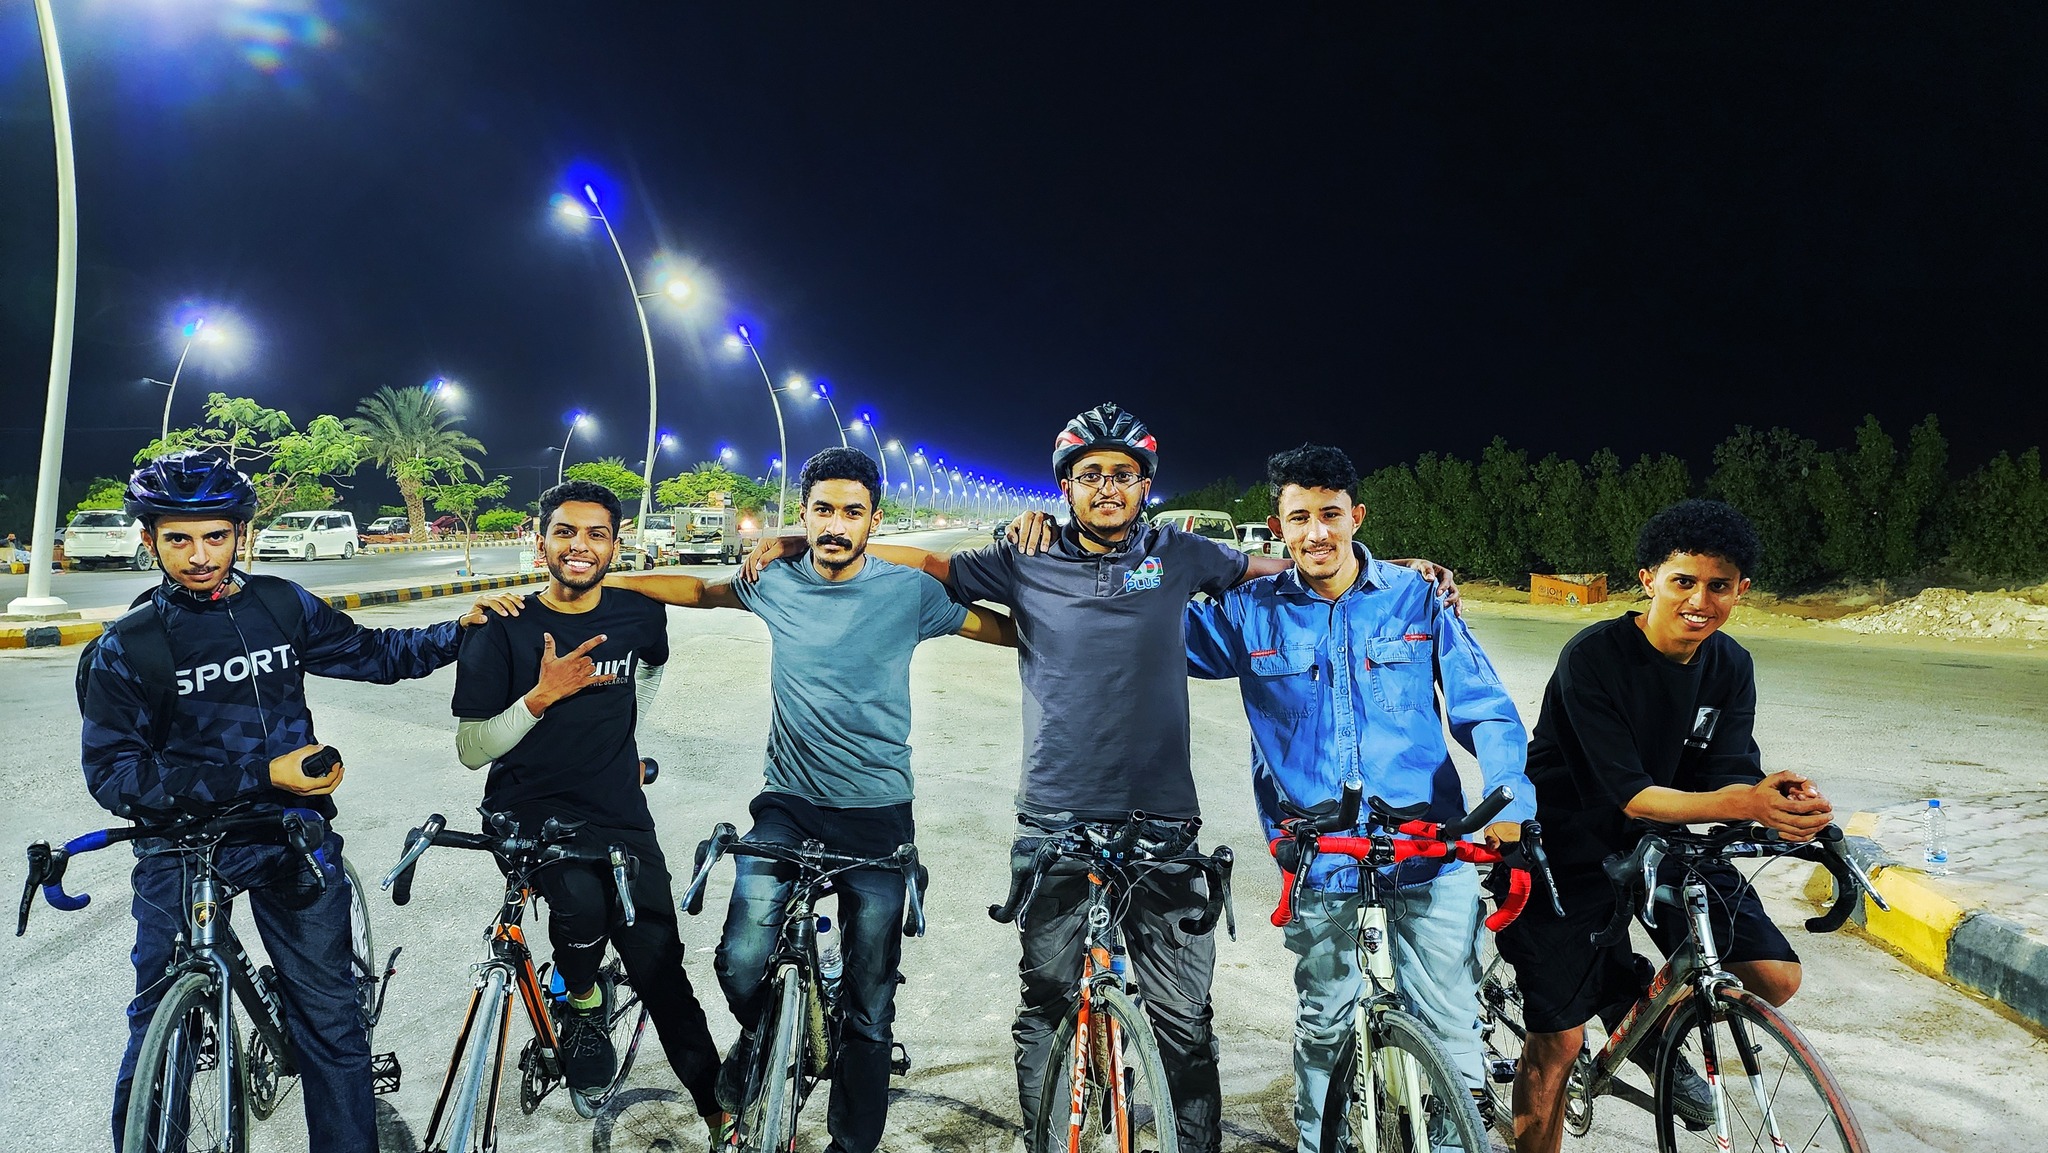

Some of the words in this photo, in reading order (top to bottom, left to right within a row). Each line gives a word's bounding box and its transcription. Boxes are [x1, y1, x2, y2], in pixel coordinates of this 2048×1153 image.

[1125, 577, 1161, 592] PLUS
[175, 643, 300, 695] SPORT
[1294, 864, 1307, 899] REFLEX
[1073, 1023, 1089, 1111] GIANT
